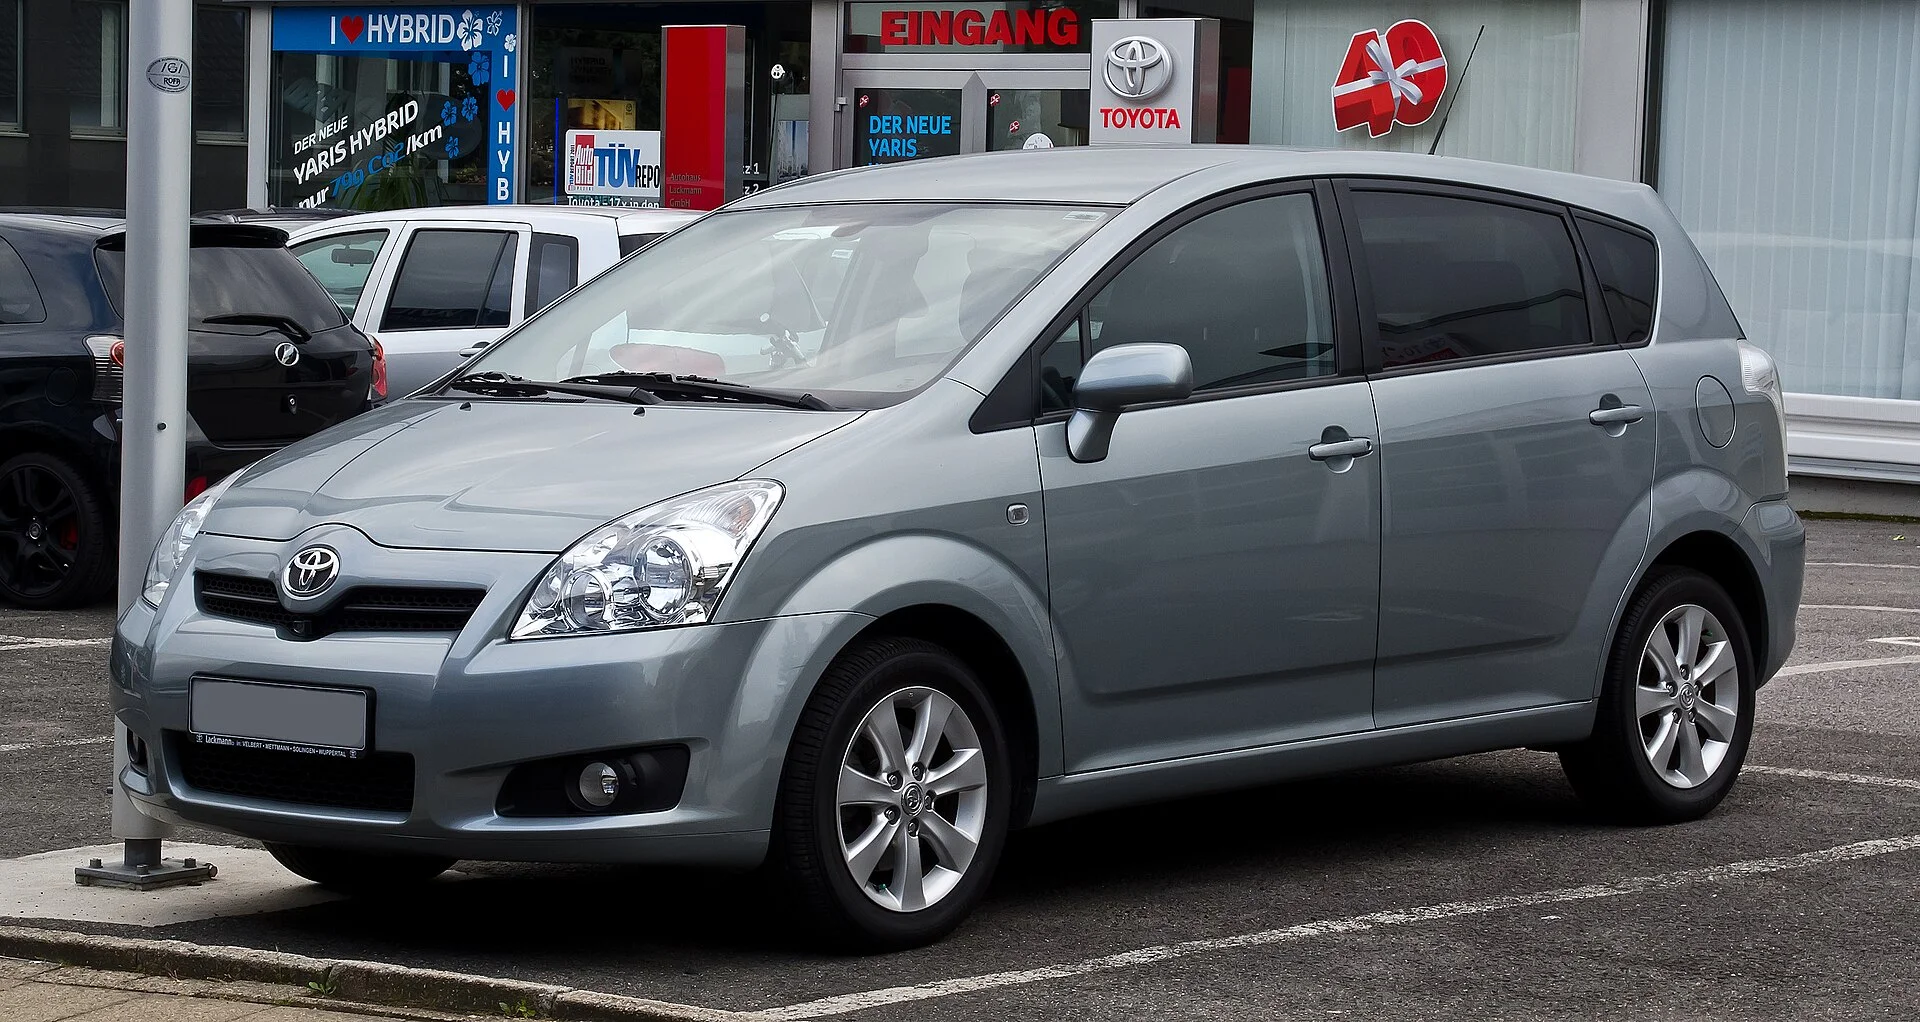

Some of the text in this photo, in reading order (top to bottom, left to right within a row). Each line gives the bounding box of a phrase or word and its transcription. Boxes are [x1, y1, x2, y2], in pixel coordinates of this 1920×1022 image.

[330, 14, 455, 45] I HYBRID
[881, 9, 1081, 46] EINGANG
[1331, 19, 1448, 138] 40
[869, 115, 952, 135] DER NEUE
[1099, 107, 1181, 130] TOYOTA
[293, 100, 419, 185] YARIS HYBRID
[294, 115, 349, 155] DER NEUE
[575, 144, 594, 165] Auto
[868, 138, 917, 157] YARIS
[575, 165, 594, 185] Bild
[594, 143, 641, 188] TÜV
[671, 172, 702, 181] Autohaus
[298, 186, 330, 208] nur
[567, 195, 600, 206] Toyota
[669, 185, 702, 195] Lackmann
[669, 198, 691, 208] GmbH
